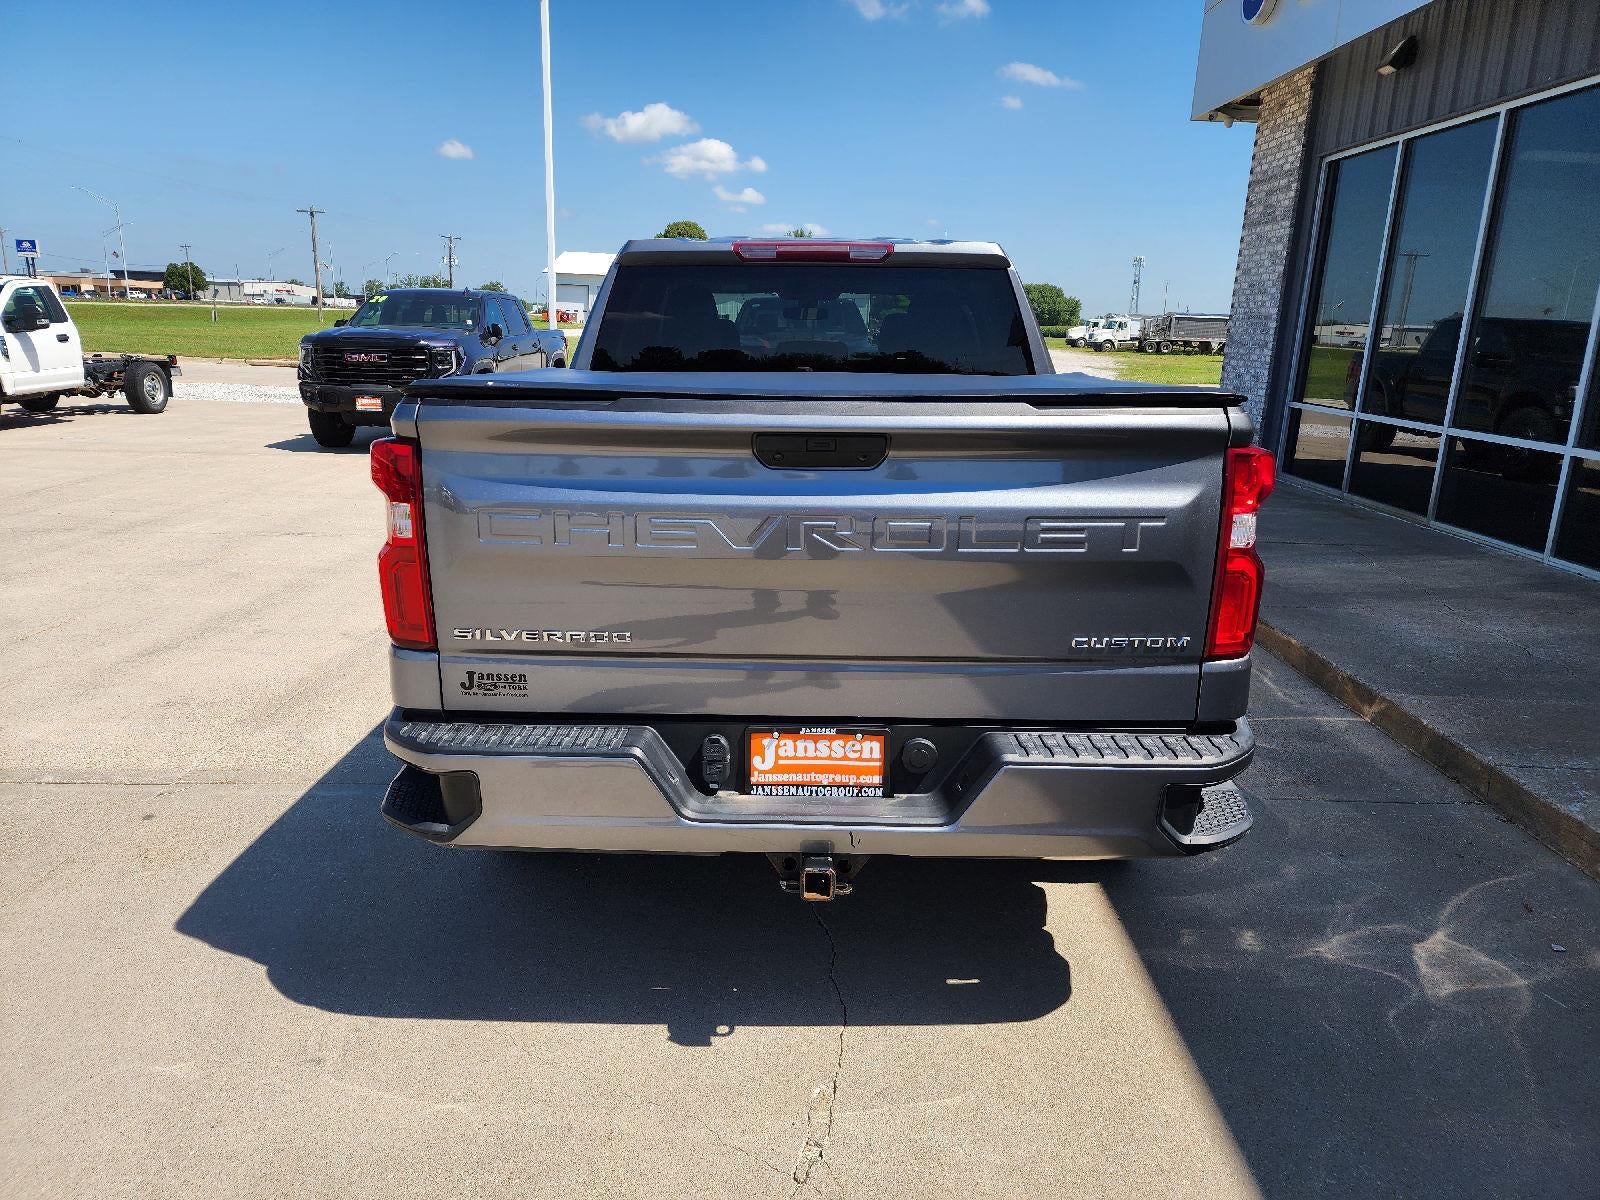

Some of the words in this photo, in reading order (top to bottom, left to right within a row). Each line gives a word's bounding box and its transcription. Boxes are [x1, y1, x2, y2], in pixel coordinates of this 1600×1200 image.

[345, 353, 388, 363] GMC
[477, 506, 1167, 554] CHEVROLET
[453, 628, 632, 643] SILVERADO
[1071, 636, 1191, 648] CUSTOM
[460, 671, 528, 690] Janssen
[753, 738, 882, 771] Janssen
[750, 771, 883, 785] Janssenautogroup.com
[750, 786, 883, 797] JANSSENAUTOGROUP.COM
